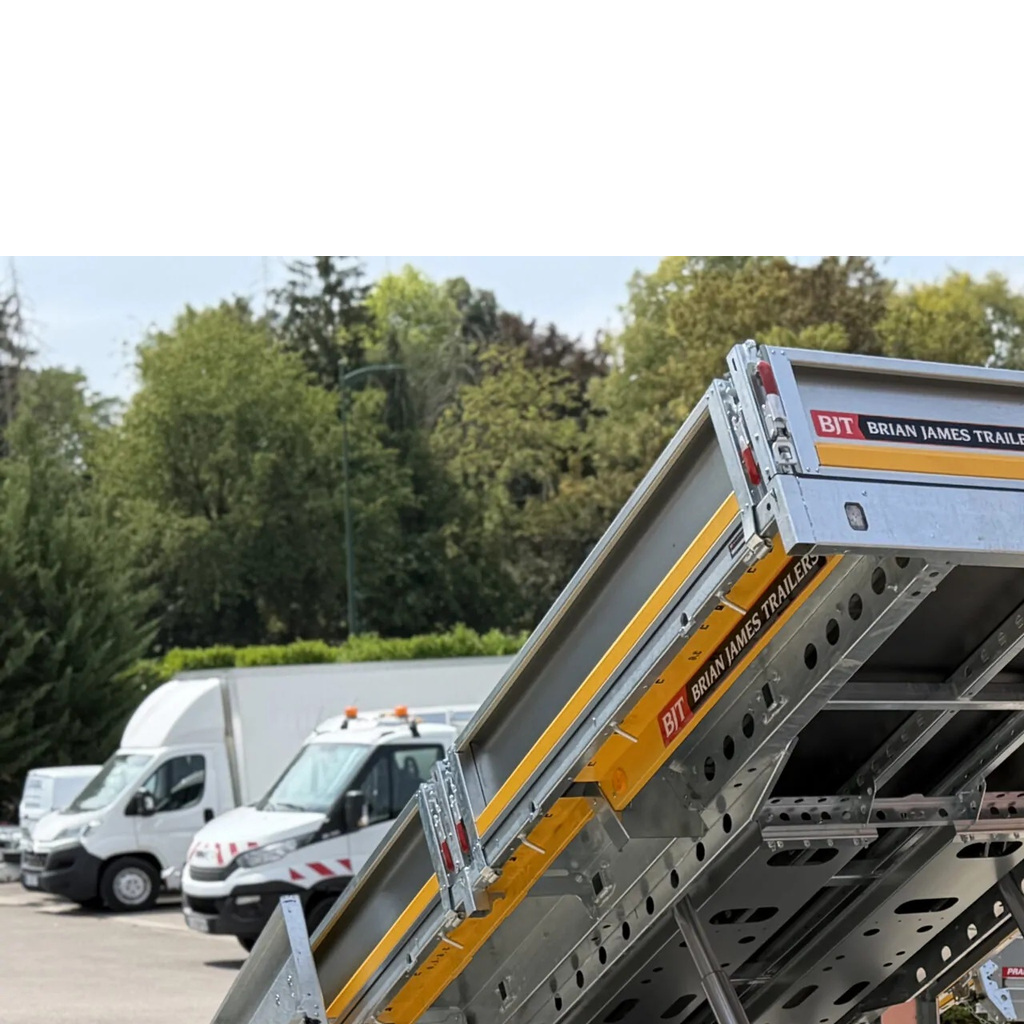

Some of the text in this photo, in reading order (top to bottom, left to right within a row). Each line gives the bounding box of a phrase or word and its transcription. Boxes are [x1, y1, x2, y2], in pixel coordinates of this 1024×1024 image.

[817, 414, 854, 435] BJT
[866, 421, 918, 438] BRIAN
[920, 425, 971, 442] JAMES
[662, 555, 819, 738] BJT BRIAN JAMES TRAILERS
